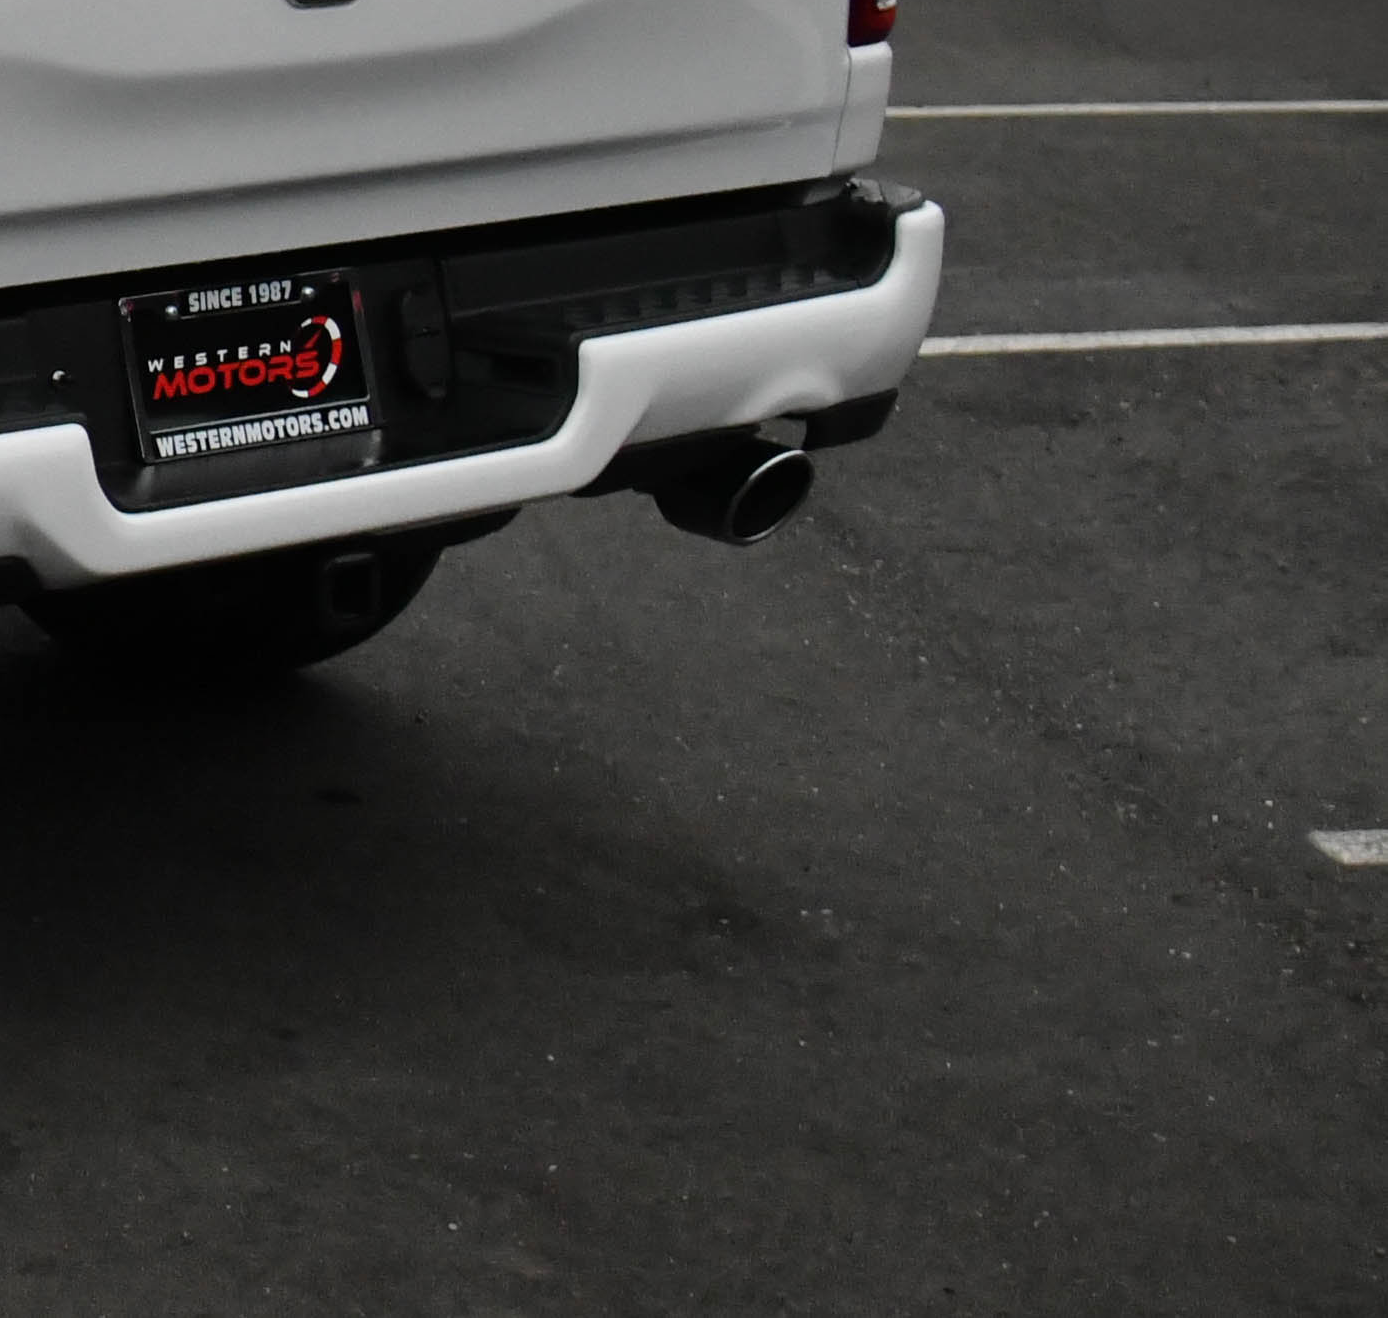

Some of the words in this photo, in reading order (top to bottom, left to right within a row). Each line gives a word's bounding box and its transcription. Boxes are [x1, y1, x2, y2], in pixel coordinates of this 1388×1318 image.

[188, 285, 243, 313] SINCE
[248, 279, 293, 306] 1987
[147, 339, 292, 373] WESTERN
[152, 350, 321, 401] MOTORS
[155, 404, 370, 459] WESTERNMOTORS.COM
